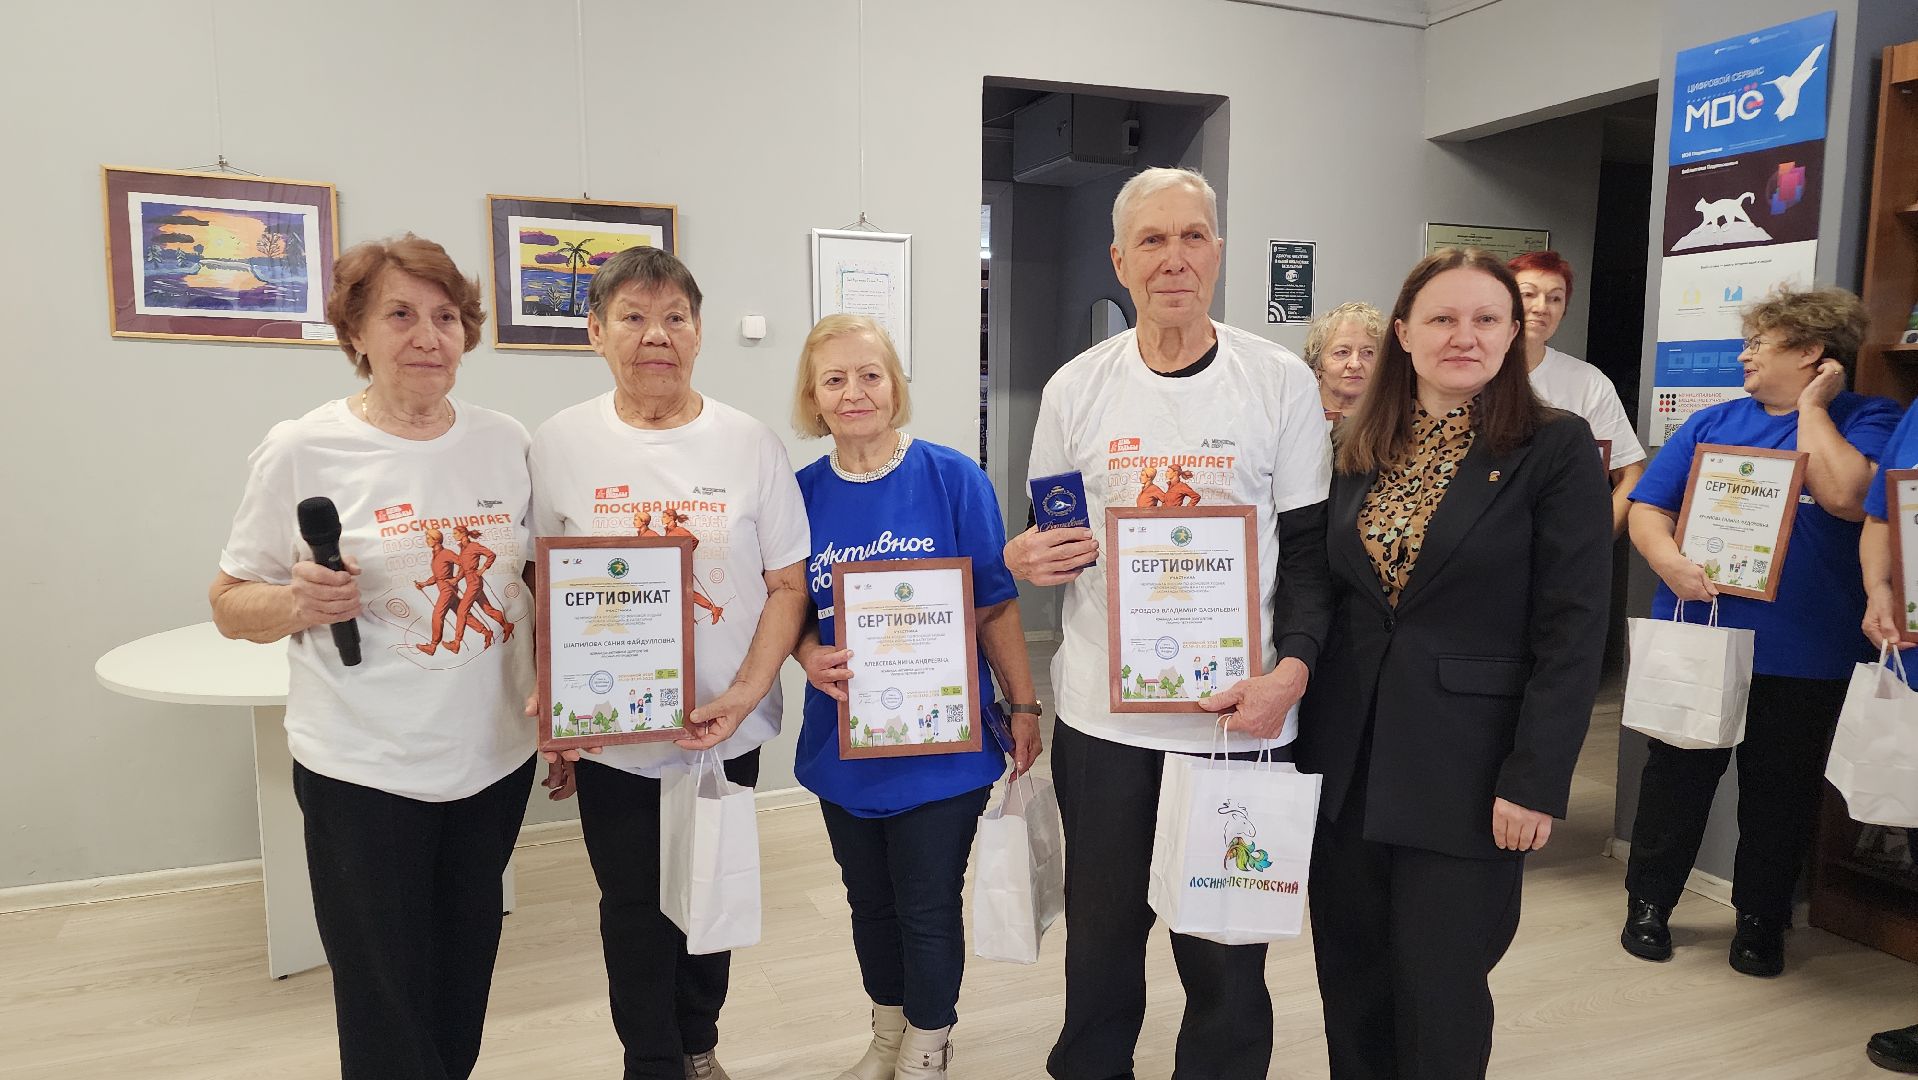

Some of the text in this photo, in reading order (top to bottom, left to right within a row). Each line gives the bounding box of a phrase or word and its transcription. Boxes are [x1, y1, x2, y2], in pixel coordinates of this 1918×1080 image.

[1108, 455, 1236, 471] МОСКВА ШАГАЕТ
[1704, 480, 1781, 499] СЕРТИФИКАТ
[593, 500, 728, 514] МОСКВА ШАГАЕТ
[380, 513, 513, 538] МОСКВА ШАГАЕТ
[810, 530, 936, 572] Активное
[1131, 557, 1235, 573] СЕРТИФИКАТ
[565, 589, 671, 607] СЕРТИФИКАТ
[857, 610, 954, 629] СЕРТИФИКАТ
[1189, 876, 1299, 895] ЛОСИНО-ПЕТРОВСКИЙ
